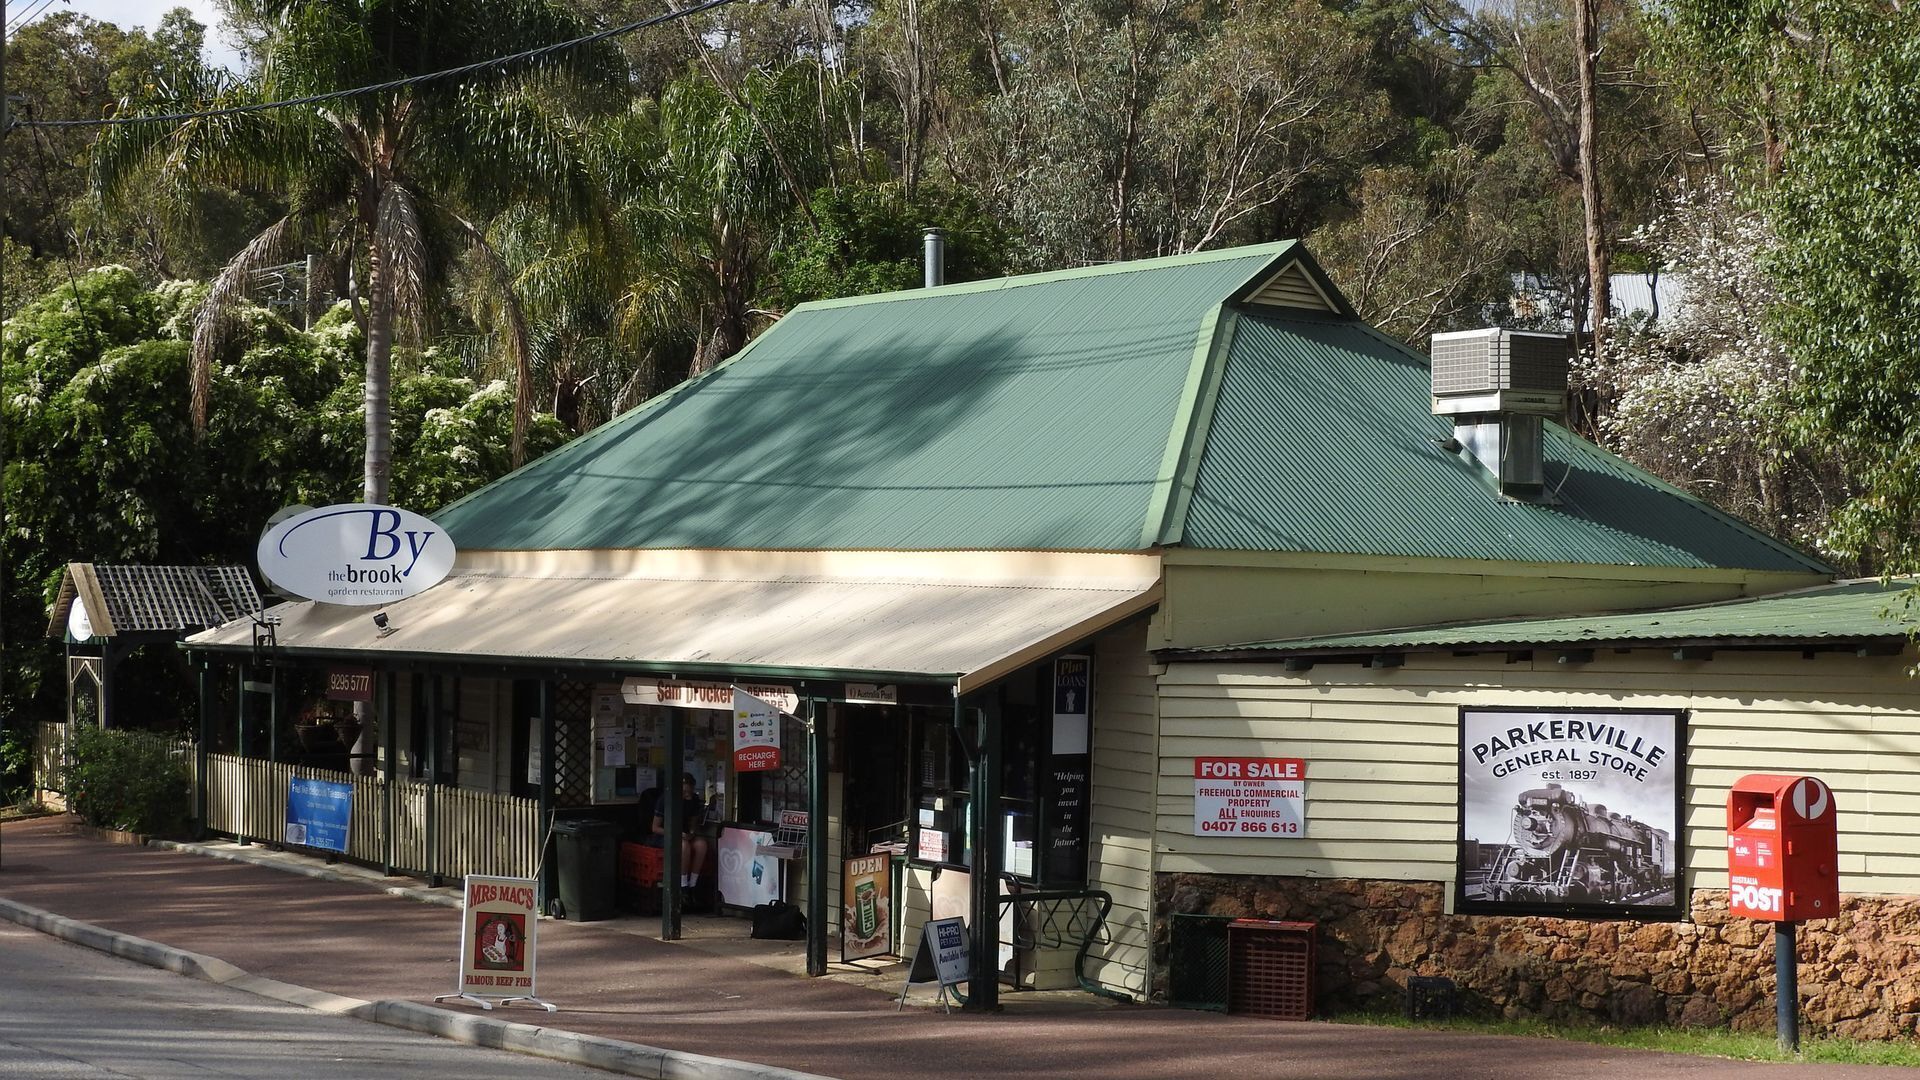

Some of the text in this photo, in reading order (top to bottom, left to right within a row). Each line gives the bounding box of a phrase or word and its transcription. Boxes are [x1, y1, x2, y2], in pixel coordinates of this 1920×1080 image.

[360, 510, 435, 577] By
[328, 564, 402, 583] the brook
[328, 587, 404, 596] garden restaurant
[1061, 660, 1083, 675] Plus
[330, 673, 369, 691] 9295 5777
[1057, 675, 1086, 687] LOANS
[656, 679, 682, 703] Sam
[1472, 720, 1666, 767] PARKERVILLE
[738, 751, 776, 761] RECHARGE
[748, 760, 766, 769] HERE
[1201, 762, 1298, 778] FOR SALE
[1492, 748, 1648, 783] GENERAL STORE
[1541, 769, 1597, 780] est. 1897
[1243, 780, 1265, 788] OWNER
[1061, 787, 1075, 796] you
[1199, 788, 1300, 799] FREEHOLD COMMERCIAL
[1058, 799, 1079, 807] invest
[1228, 798, 1271, 808] PROPERTY
[1063, 812, 1072, 820] in
[1219, 808, 1281, 819] ALL ENQUIRIES
[1061, 824, 1073, 833] the
[1201, 821, 1298, 833] 0407 866 613
[850, 857, 883, 876] OPEN
[469, 884, 534, 910] MRS MAC'S
[1731, 884, 1783, 912] POST
[465, 975, 532, 987] FAMOUS BEEF PIES
